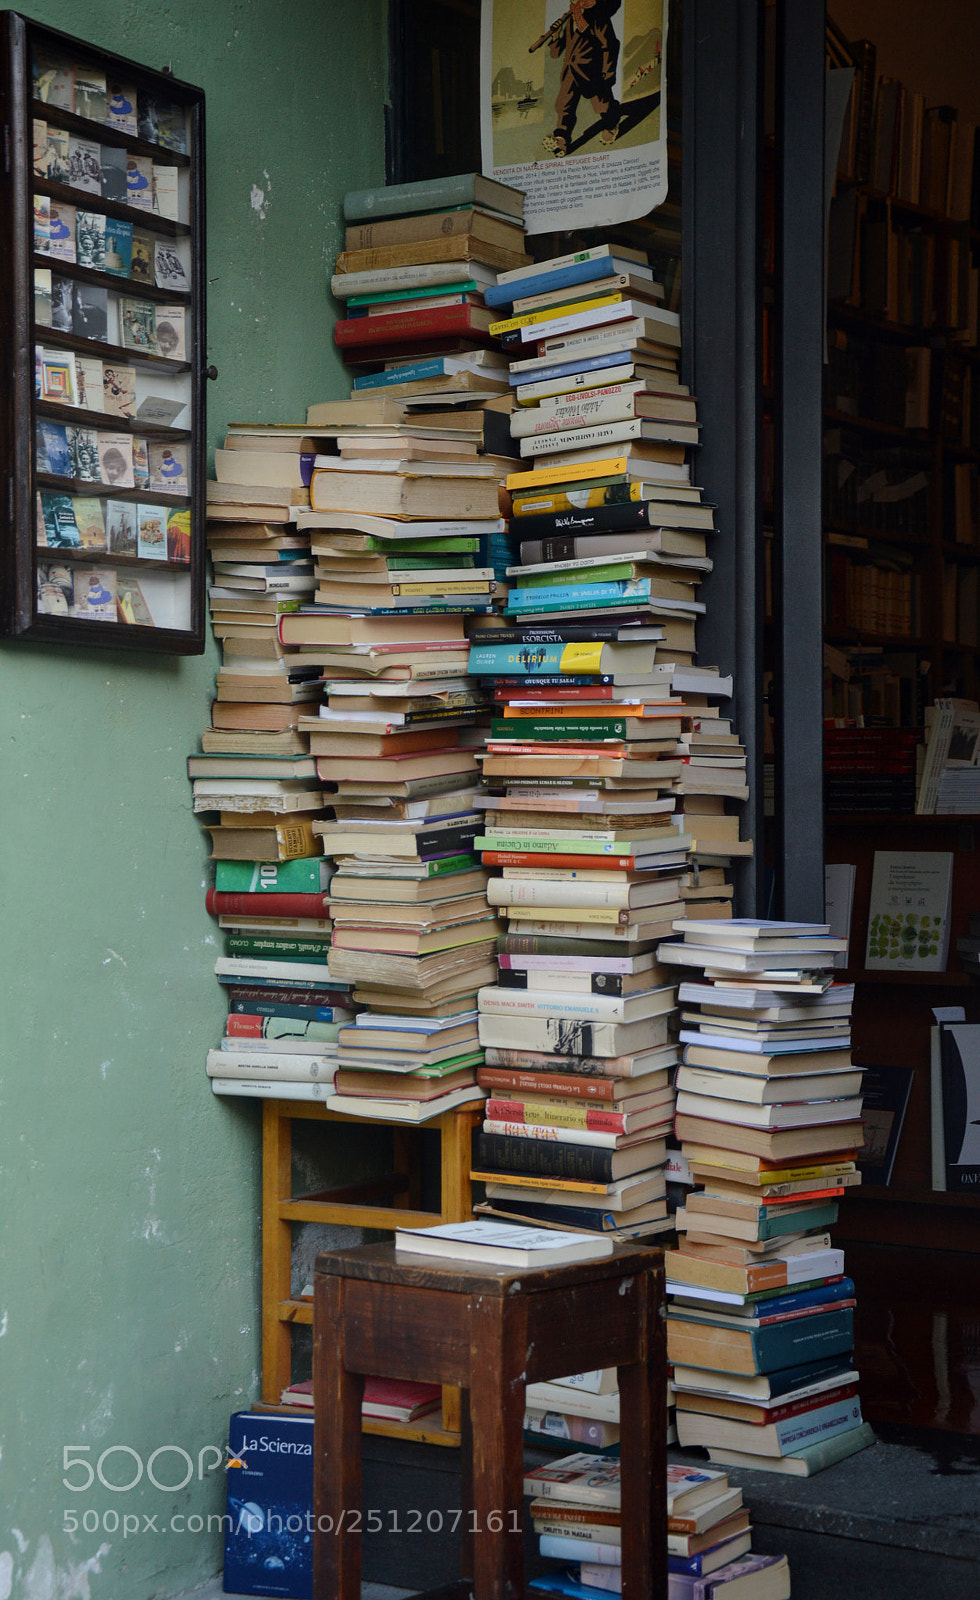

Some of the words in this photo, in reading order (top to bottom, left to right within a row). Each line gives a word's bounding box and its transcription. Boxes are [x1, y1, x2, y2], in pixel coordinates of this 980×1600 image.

[493, 168, 516, 176] VENDITA
[523, 164, 544, 172] NATALE
[545, 161, 564, 169] SPIRAL
[565, 157, 591, 166] REFUGEE
[522, 634, 564, 643] ESORCISTA
[508, 654, 558, 663] DELIRIUM
[520, 706, 564, 714] SCONTRINI
[496, 841, 522, 850] Cucina
[523, 842, 531, 850] in
[532, 842, 559, 850] Adamo
[260, 865, 278, 888] 10
[230, 939, 249, 947] CUOMO
[233, 1022, 254, 1030] Thomas
[544, 1112, 578, 1122] Itinerario
[578, 1116, 612, 1128] spagnuolo
[780, 1435, 796, 1446] IMPRESA
[243, 1435, 258, 1451] La
[259, 1436, 312, 1456] Scienza
[543, 1526, 562, 1534] DELITTI
[572, 1530, 592, 1539] NATALE
